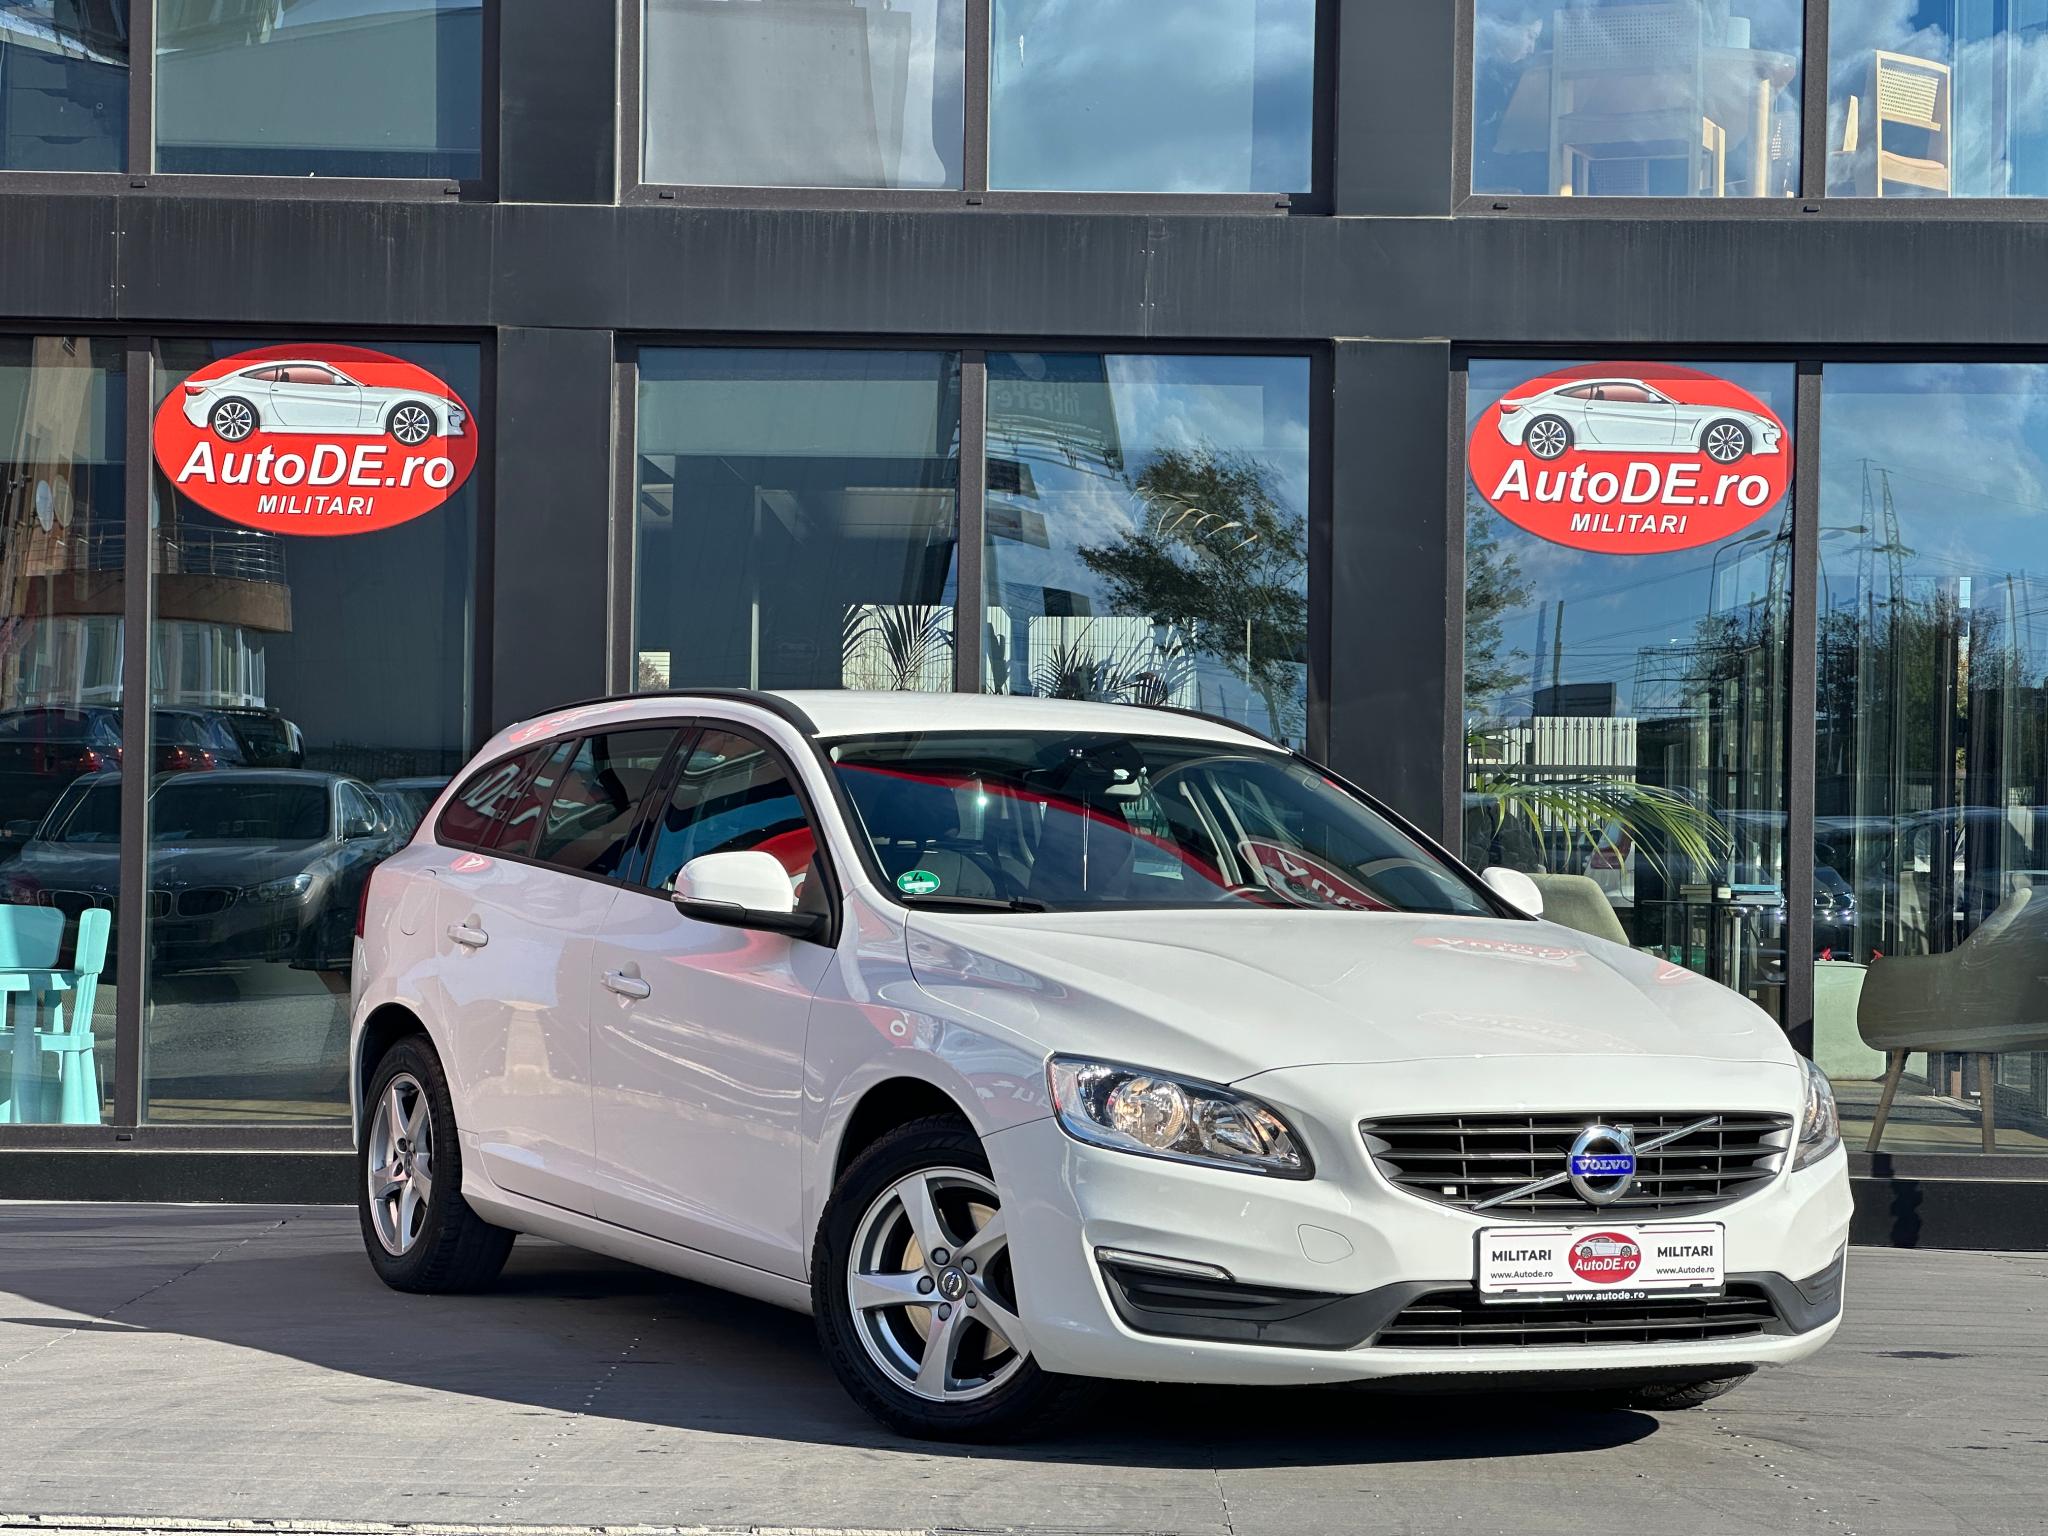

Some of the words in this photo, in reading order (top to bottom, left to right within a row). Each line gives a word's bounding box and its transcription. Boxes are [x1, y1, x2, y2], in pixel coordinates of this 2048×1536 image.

[176, 441, 456, 489] AutoDE.ro
[1491, 459, 1770, 507] AutoDE.ro
[256, 494, 375, 515] MILITARI
[1570, 513, 1688, 534] MILITARI
[912, 872, 924, 882] 4
[1576, 1159, 1631, 1171] VOLVO
[1491, 1249, 1552, 1262] MILITARI
[1656, 1245, 1714, 1258] MILITARI
[1574, 1257, 1637, 1273] AutoDE.ro
[1656, 1265, 1715, 1275] www.Autode.ro
[1490, 1270, 1553, 1279] www.Autode.ro
[1566, 1290, 1646, 1301] www.autode.ro
